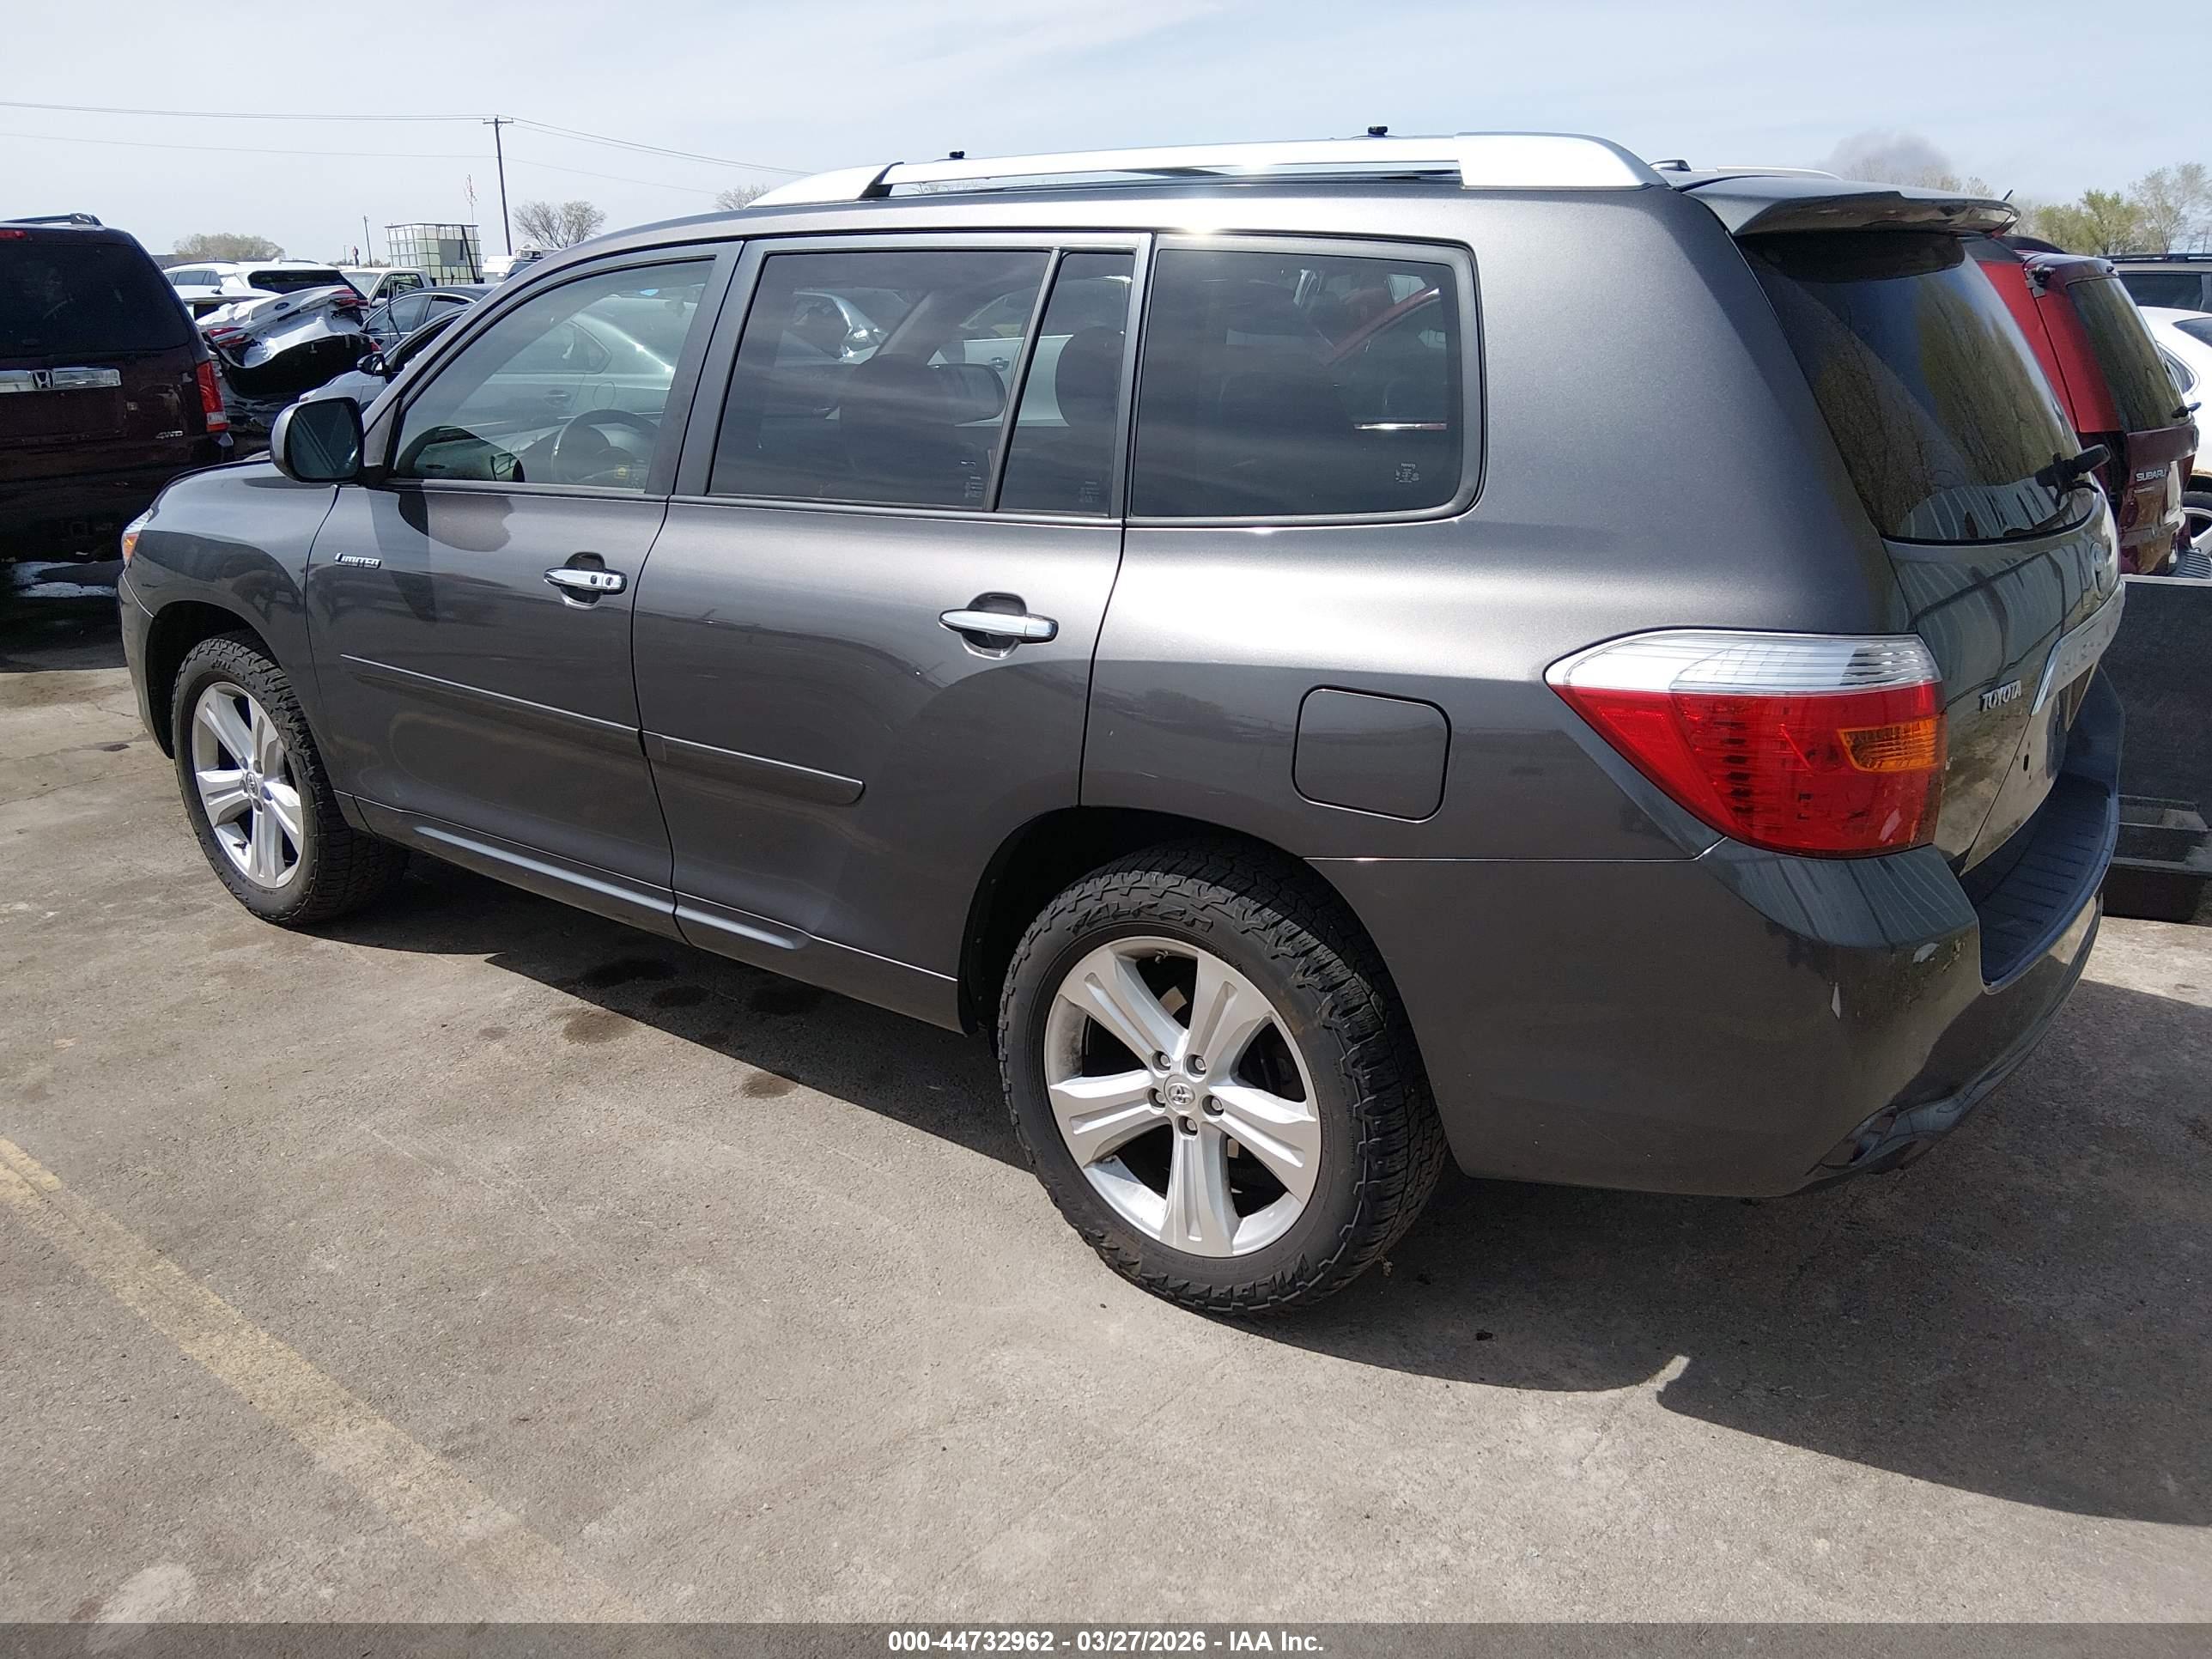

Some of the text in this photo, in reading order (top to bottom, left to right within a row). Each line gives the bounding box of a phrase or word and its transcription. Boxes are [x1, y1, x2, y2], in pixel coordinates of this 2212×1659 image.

[155, 430, 183, 439] 4WD
[2136, 469, 2166, 482] SUBARU
[1979, 679, 2021, 712] TOYOTA
